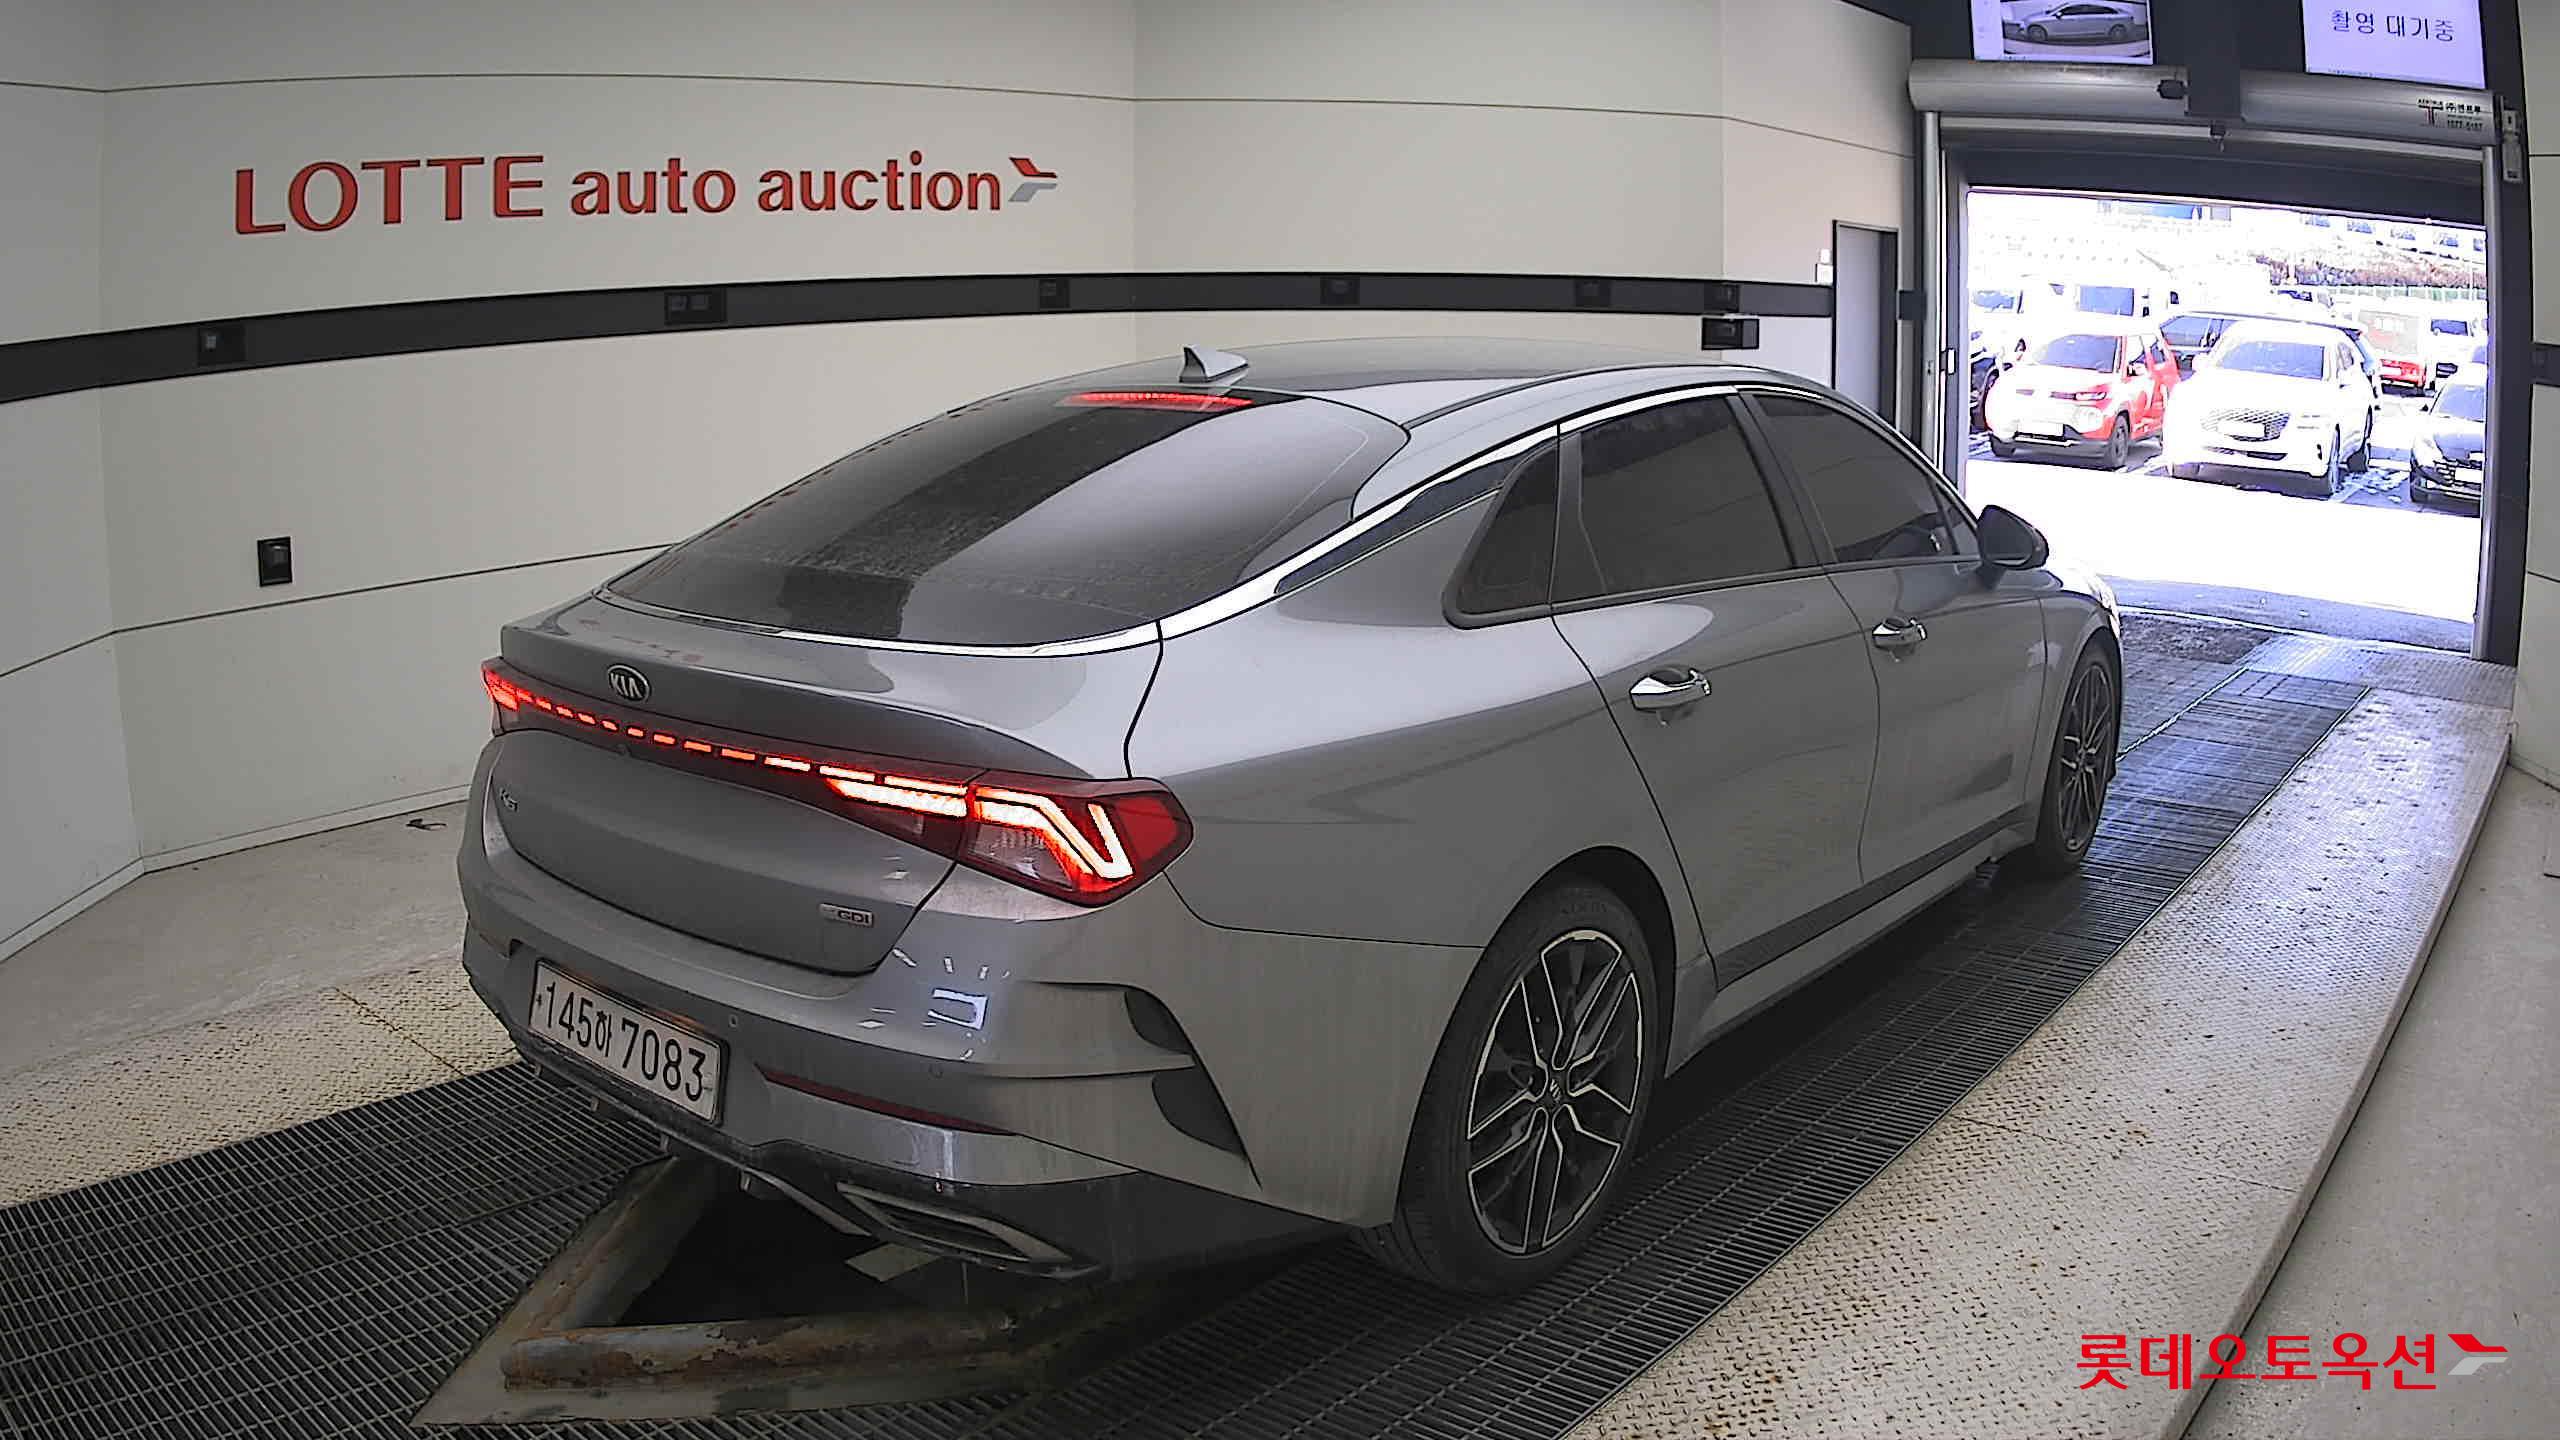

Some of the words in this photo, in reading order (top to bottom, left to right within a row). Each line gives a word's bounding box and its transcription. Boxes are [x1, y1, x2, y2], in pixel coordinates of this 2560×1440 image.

[2331, 9, 2376, 35] 촬영
[2386, 15, 2457, 43] 대기중
[235, 155, 545, 235] LOTTE
[569, 156, 738, 216] auto
[757, 150, 1003, 213] auction
[609, 671, 645, 699] KIA
[546, 981, 613, 1058] 145하
[621, 1017, 708, 1103] 7083
